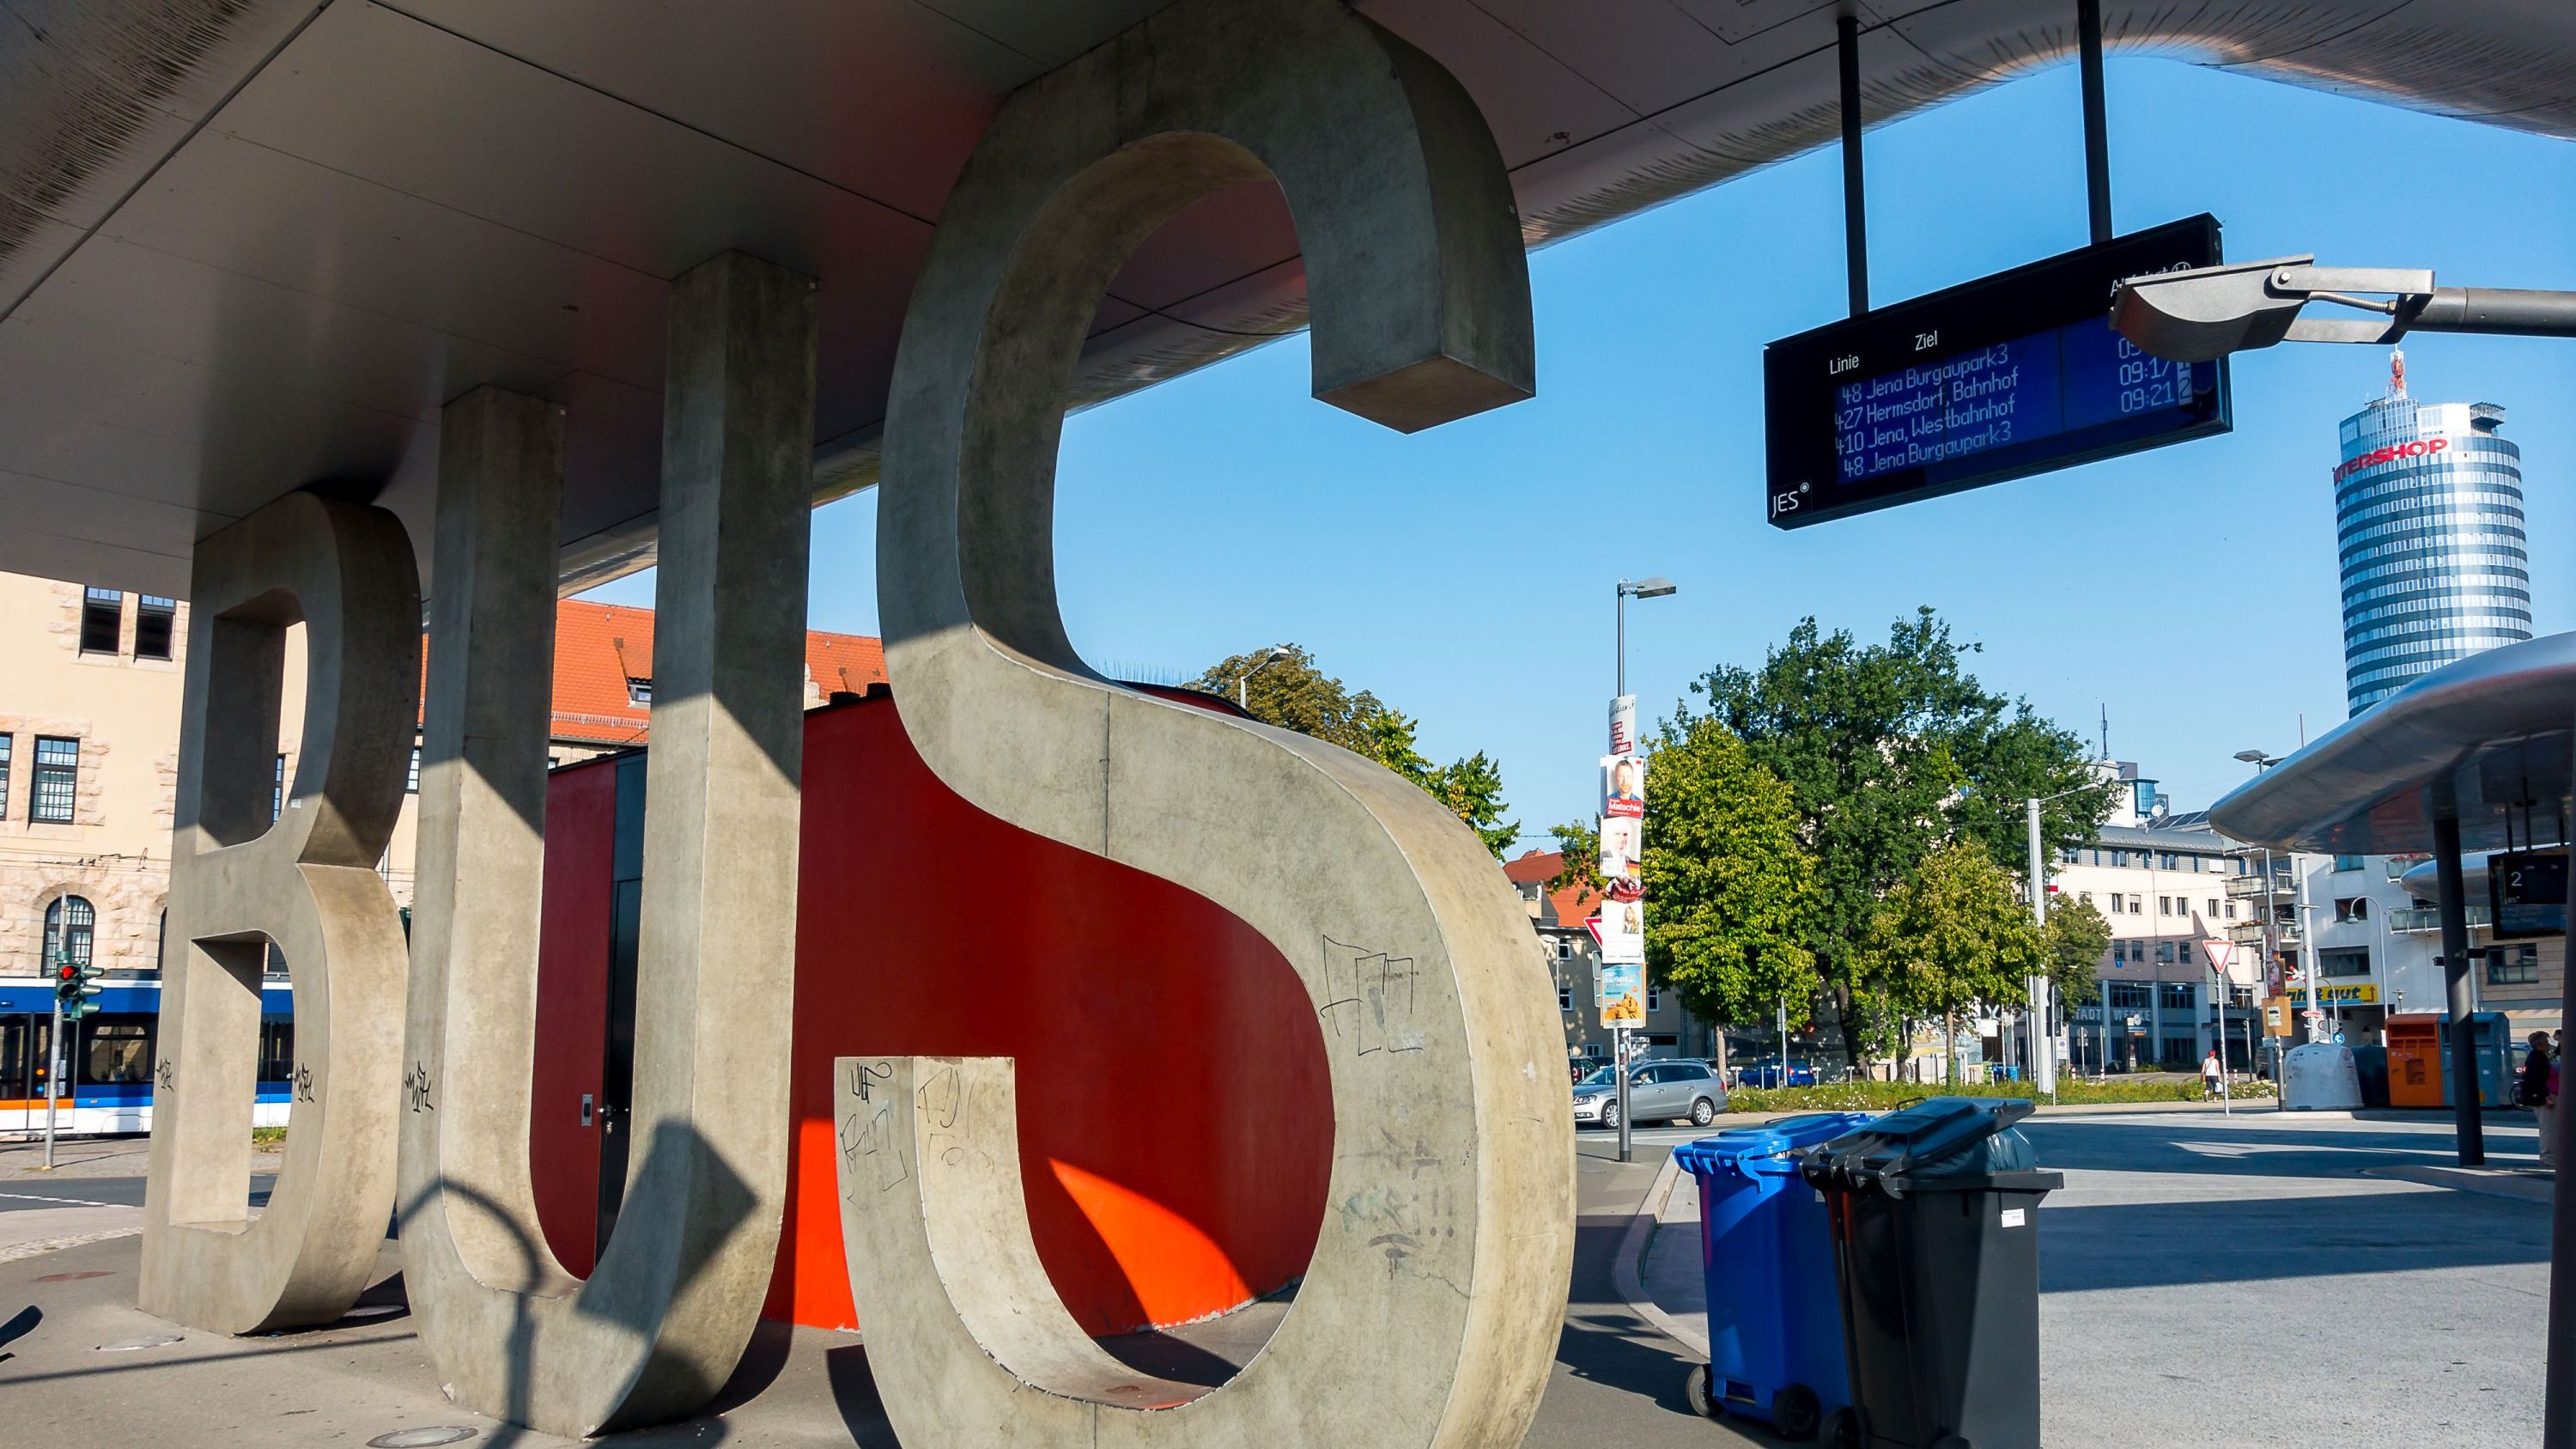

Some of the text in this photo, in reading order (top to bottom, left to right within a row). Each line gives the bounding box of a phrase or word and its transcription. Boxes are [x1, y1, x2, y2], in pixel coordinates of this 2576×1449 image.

[1830, 330, 1938, 374] Linie Ziel
[1835, 366, 2019, 430] 427 Hermsdorf, Bahnhof
[1842, 383, 1862, 405] 48
[1867, 379, 1903, 399] Jena
[2121, 381, 2174, 412] 09:21
[1835, 393, 2015, 456] 410 Jena, Westbahnhof
[1844, 456, 1863, 478] 48
[1869, 453, 1905, 472] Jena
[1771, 490, 1799, 519] JES
[136, 0, 1576, 1449] BUS
[2511, 871, 2523, 886] 2
[2071, 1008, 2101, 1020] TADT
